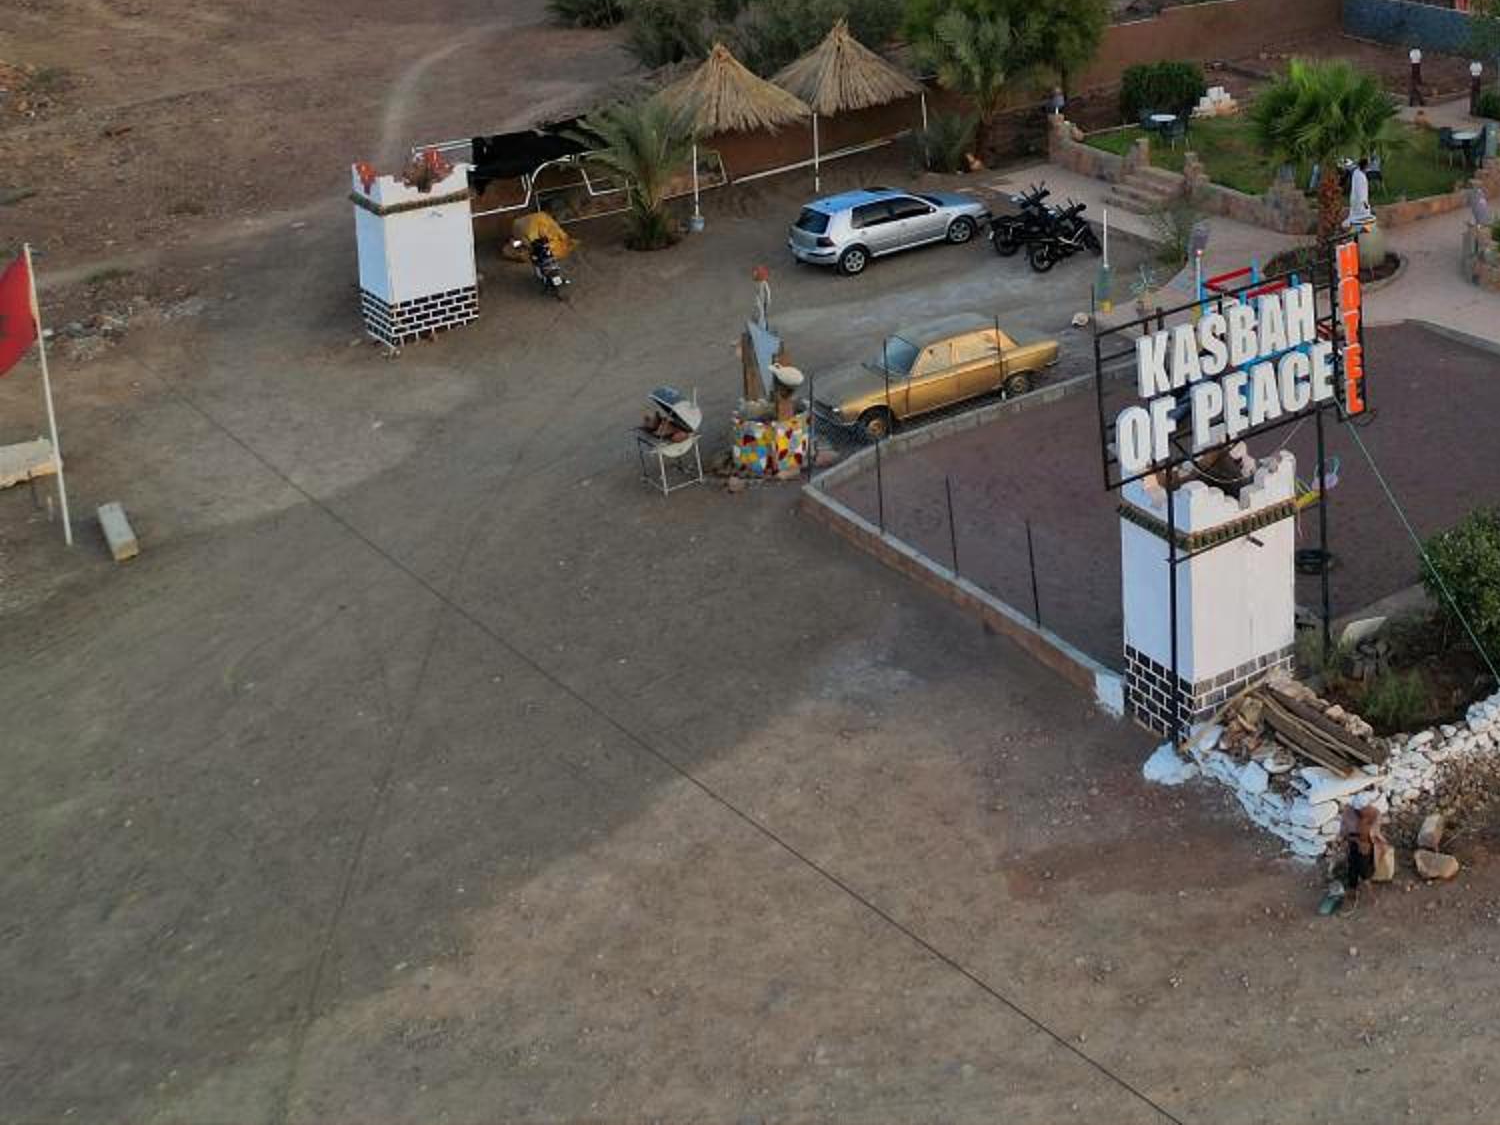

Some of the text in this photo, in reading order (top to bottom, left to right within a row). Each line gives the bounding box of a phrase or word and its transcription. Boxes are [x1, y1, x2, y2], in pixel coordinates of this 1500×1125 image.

[1136, 282, 1315, 398] KASBAH
[1336, 241, 1364, 414] HOTEL
[1115, 340, 1335, 472] OF PEACE
